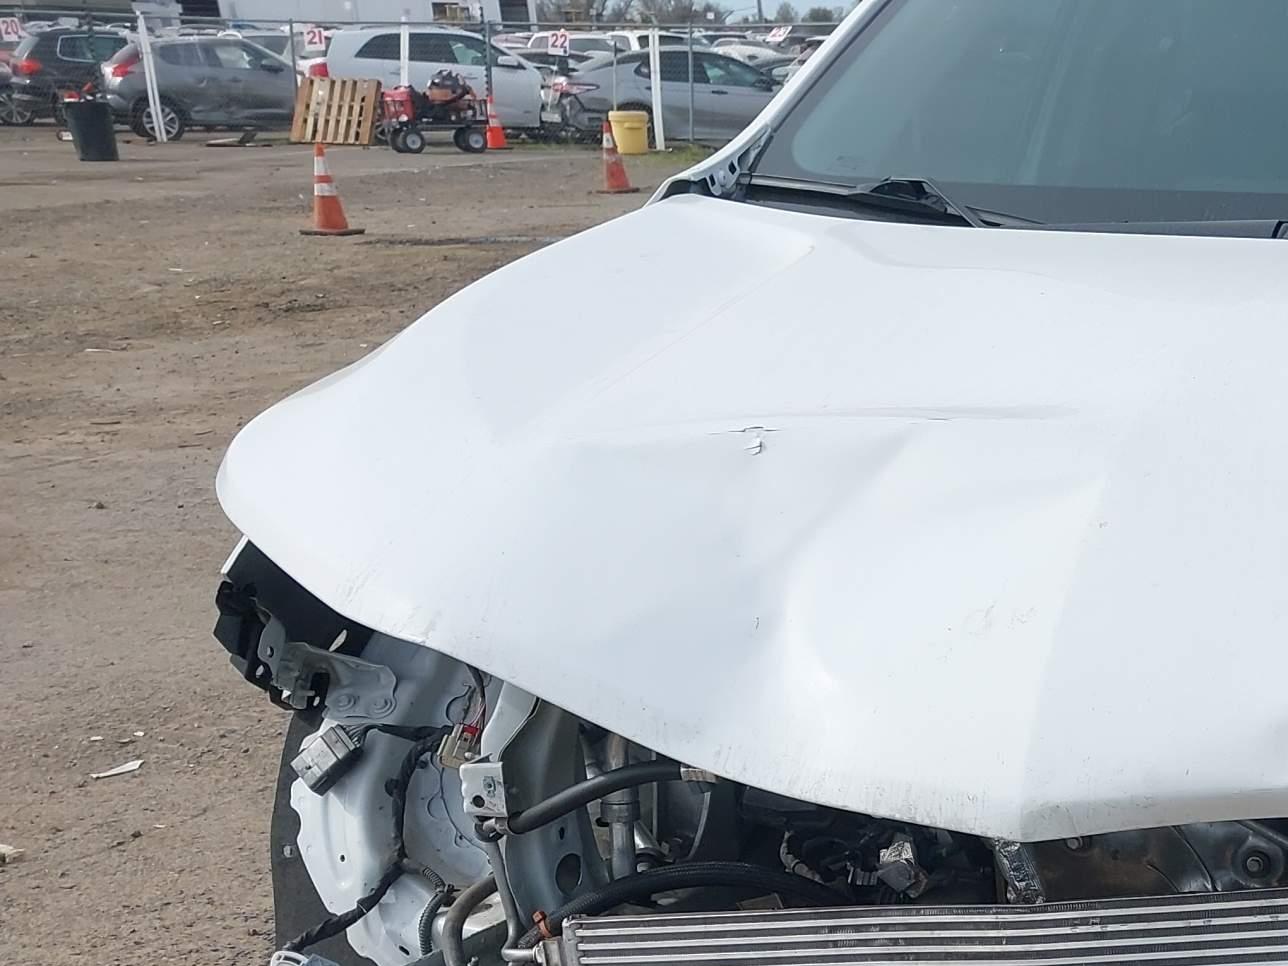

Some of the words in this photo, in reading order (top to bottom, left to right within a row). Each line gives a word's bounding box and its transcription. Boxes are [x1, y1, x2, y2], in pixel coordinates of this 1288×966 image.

[1, 19, 19, 36] 20
[306, 29, 323, 45] 21
[550, 32, 567, 49] 22
